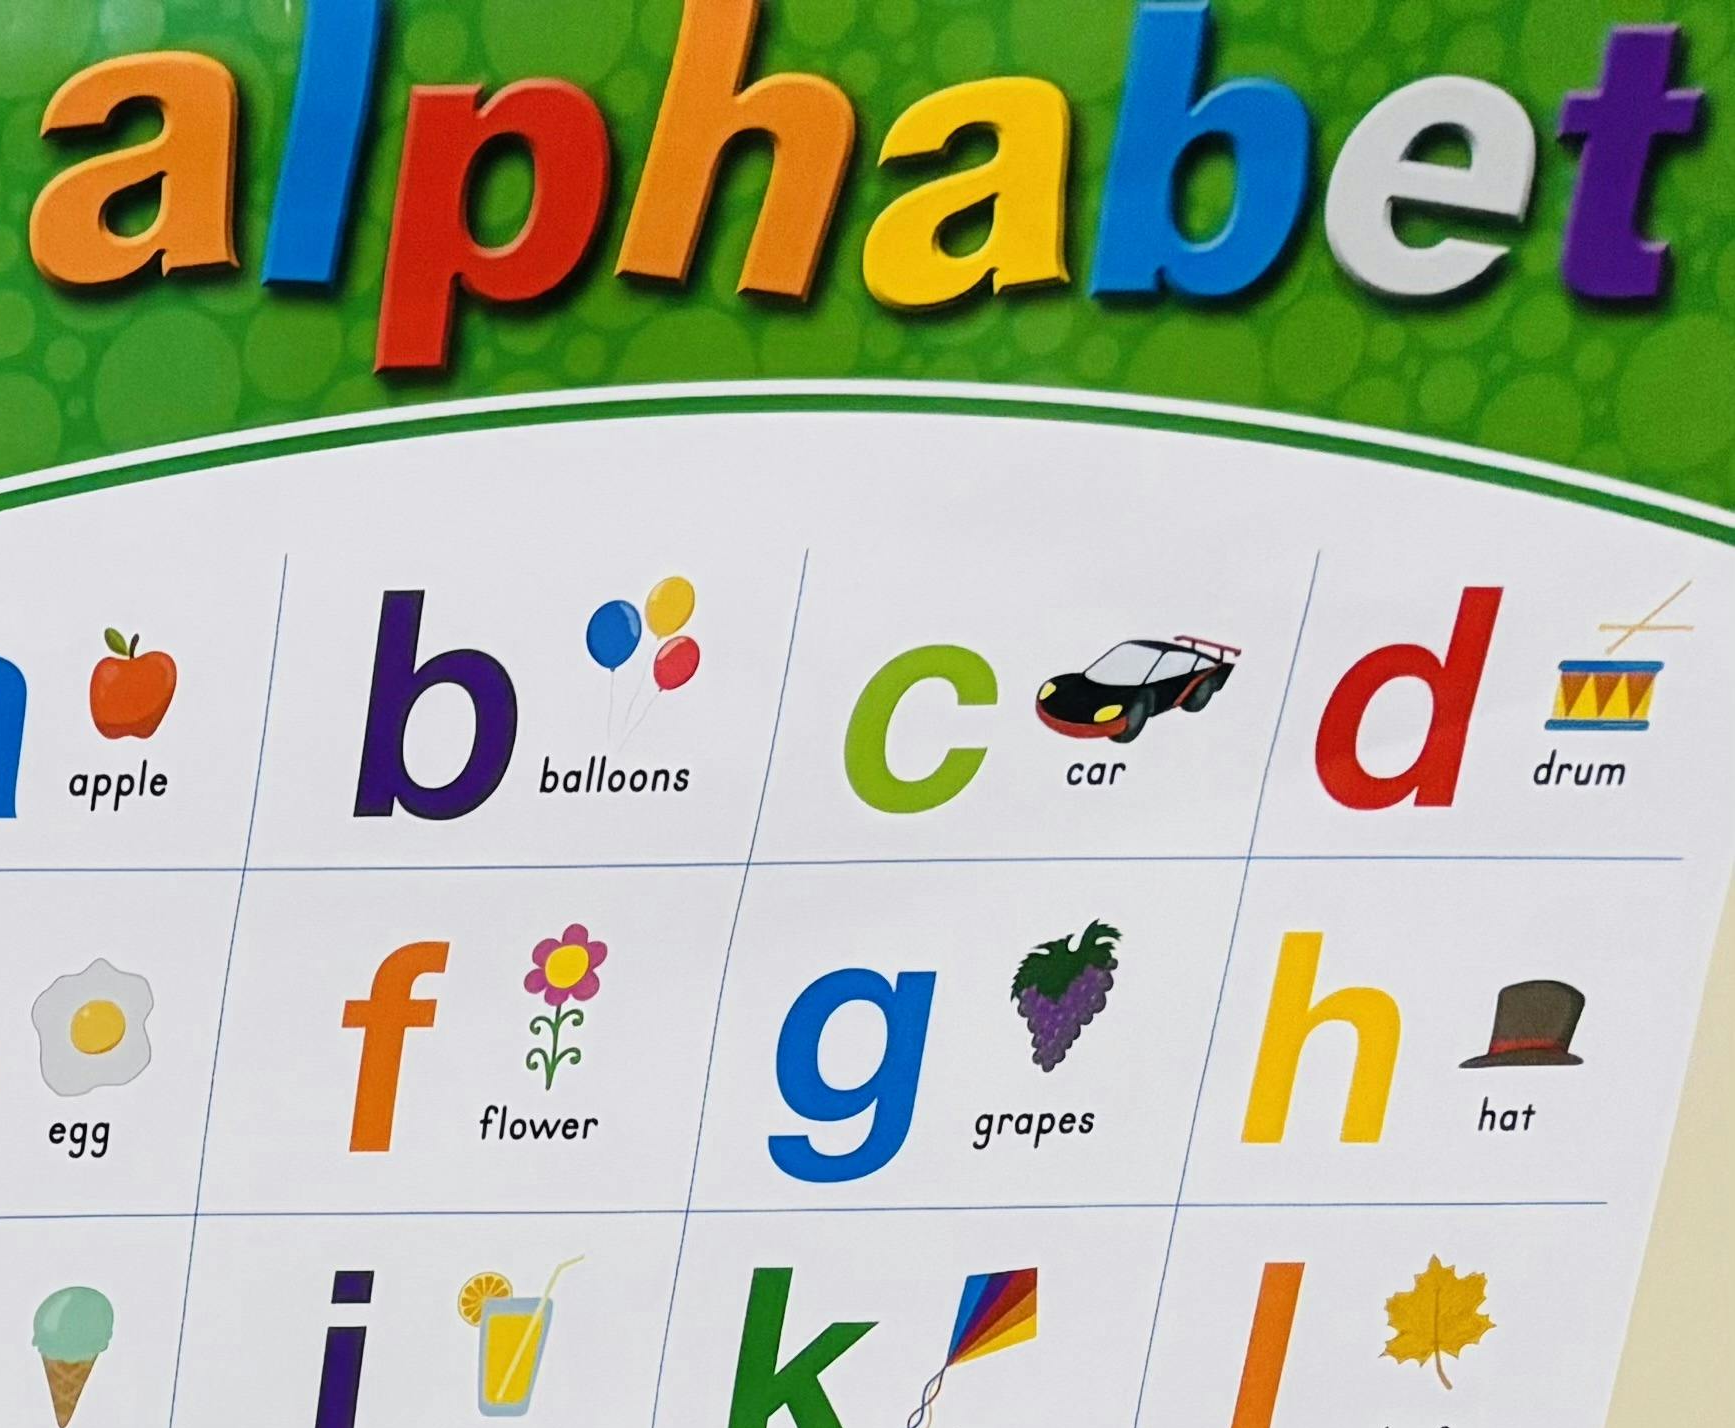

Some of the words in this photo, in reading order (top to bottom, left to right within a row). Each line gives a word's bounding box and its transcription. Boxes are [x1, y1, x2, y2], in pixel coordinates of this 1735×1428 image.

[27, 0, 1702, 375] alphabet
[352, 589, 519, 822] b
[1314, 585, 1505, 811] d
[843, 644, 999, 815] c
[68, 759, 168, 813] apple
[539, 755, 690, 794] balloons
[1066, 762, 1127, 786] car
[1533, 748, 1626, 786] drum
[341, 940, 451, 1153] f
[1240, 930, 1403, 1145] h
[767, 967, 938, 1184] g
[48, 1121, 111, 1159] egg
[479, 1104, 599, 1141] flower
[972, 1112, 1096, 1151] grapes
[1477, 1095, 1537, 1132] hat
